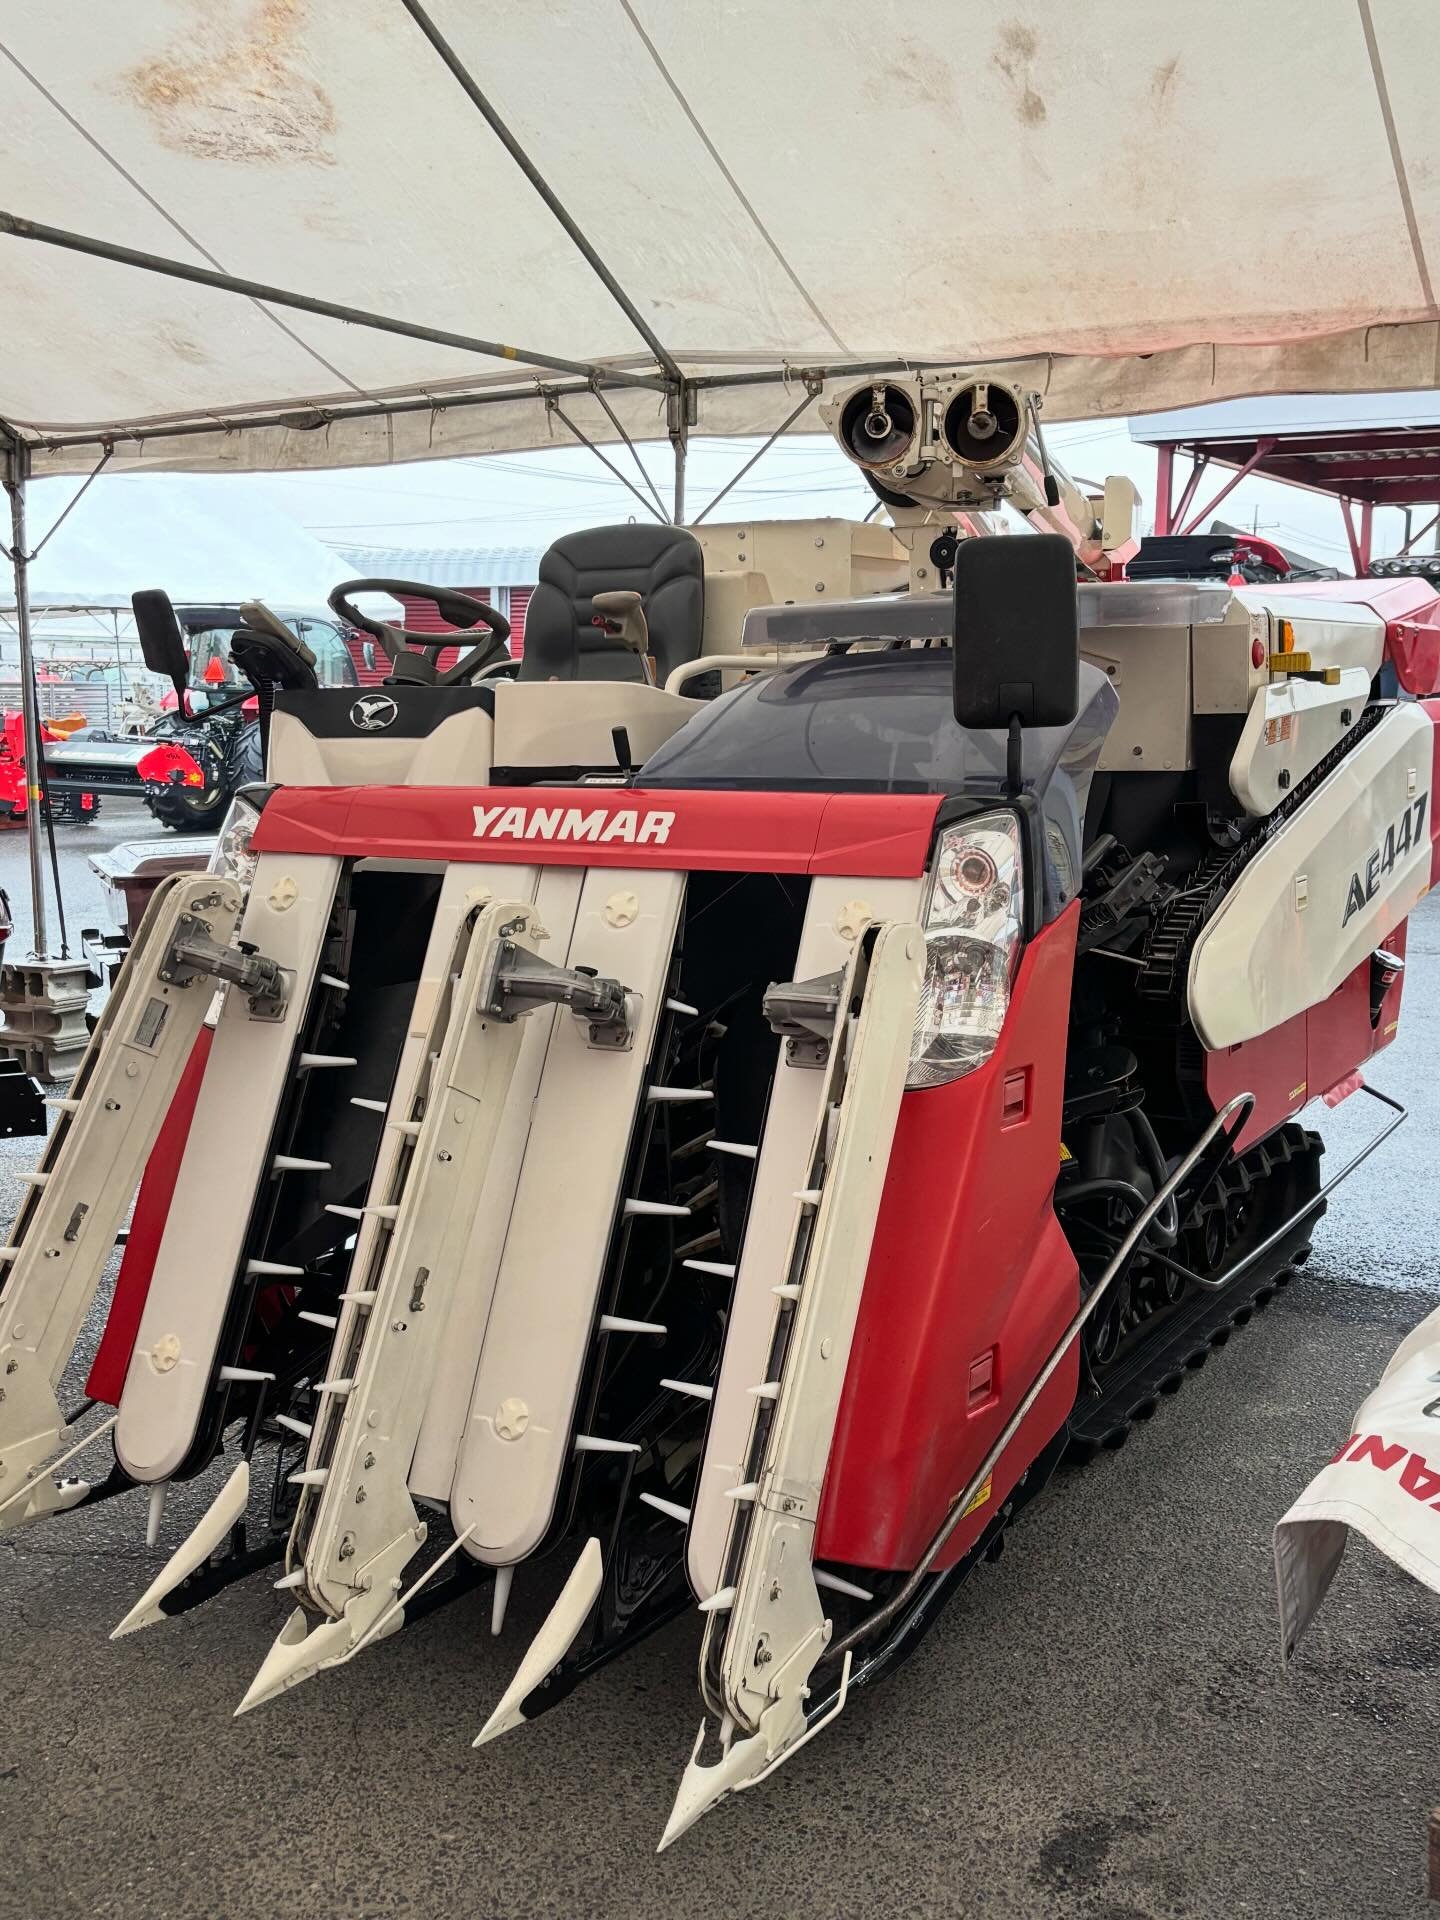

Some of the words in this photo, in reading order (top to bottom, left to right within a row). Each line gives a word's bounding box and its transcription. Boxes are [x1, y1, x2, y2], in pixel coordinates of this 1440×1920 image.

[472, 806, 676, 844] YANMAR
[1342, 791, 1428, 928] AE447
[1329, 1434, 1440, 1513] AN
